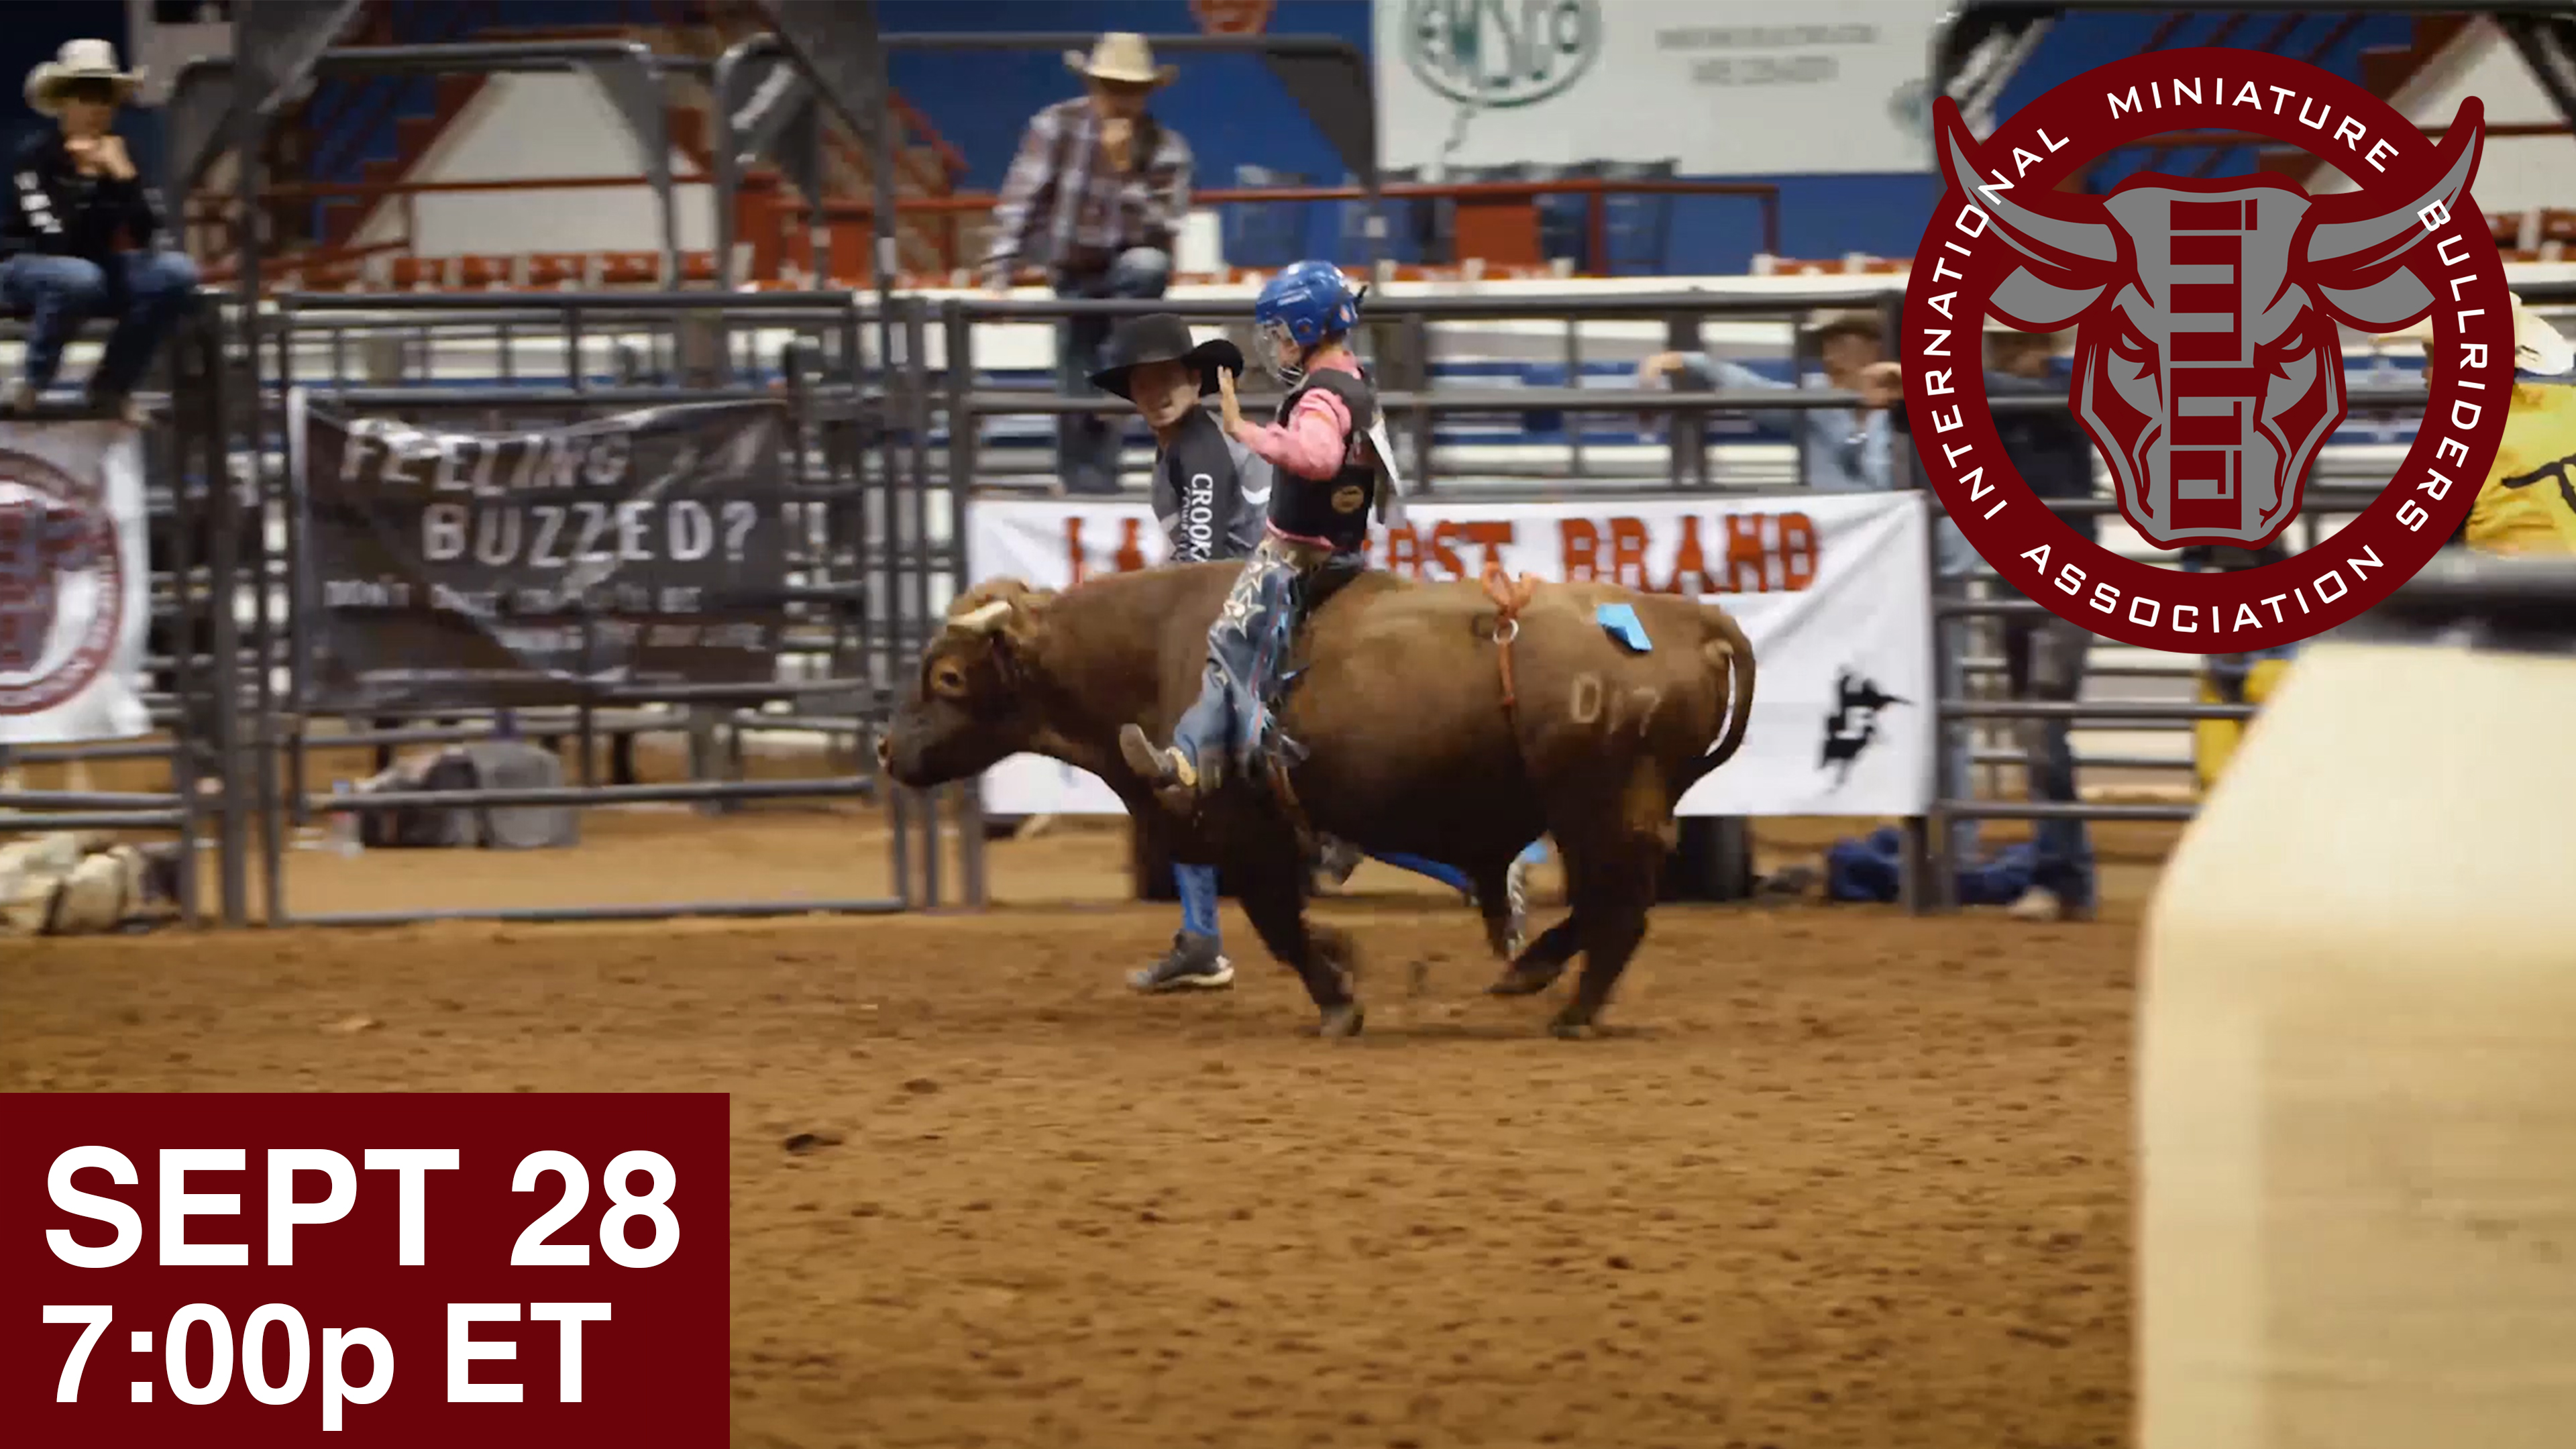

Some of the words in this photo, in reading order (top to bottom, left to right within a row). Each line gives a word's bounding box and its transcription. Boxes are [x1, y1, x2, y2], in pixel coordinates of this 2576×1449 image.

[339, 425, 631, 495] FEELING
[422, 500, 757, 567] BUZZED?
[1188, 473, 1213, 562] CROOK
[1558, 512, 1819, 593] BRAND
